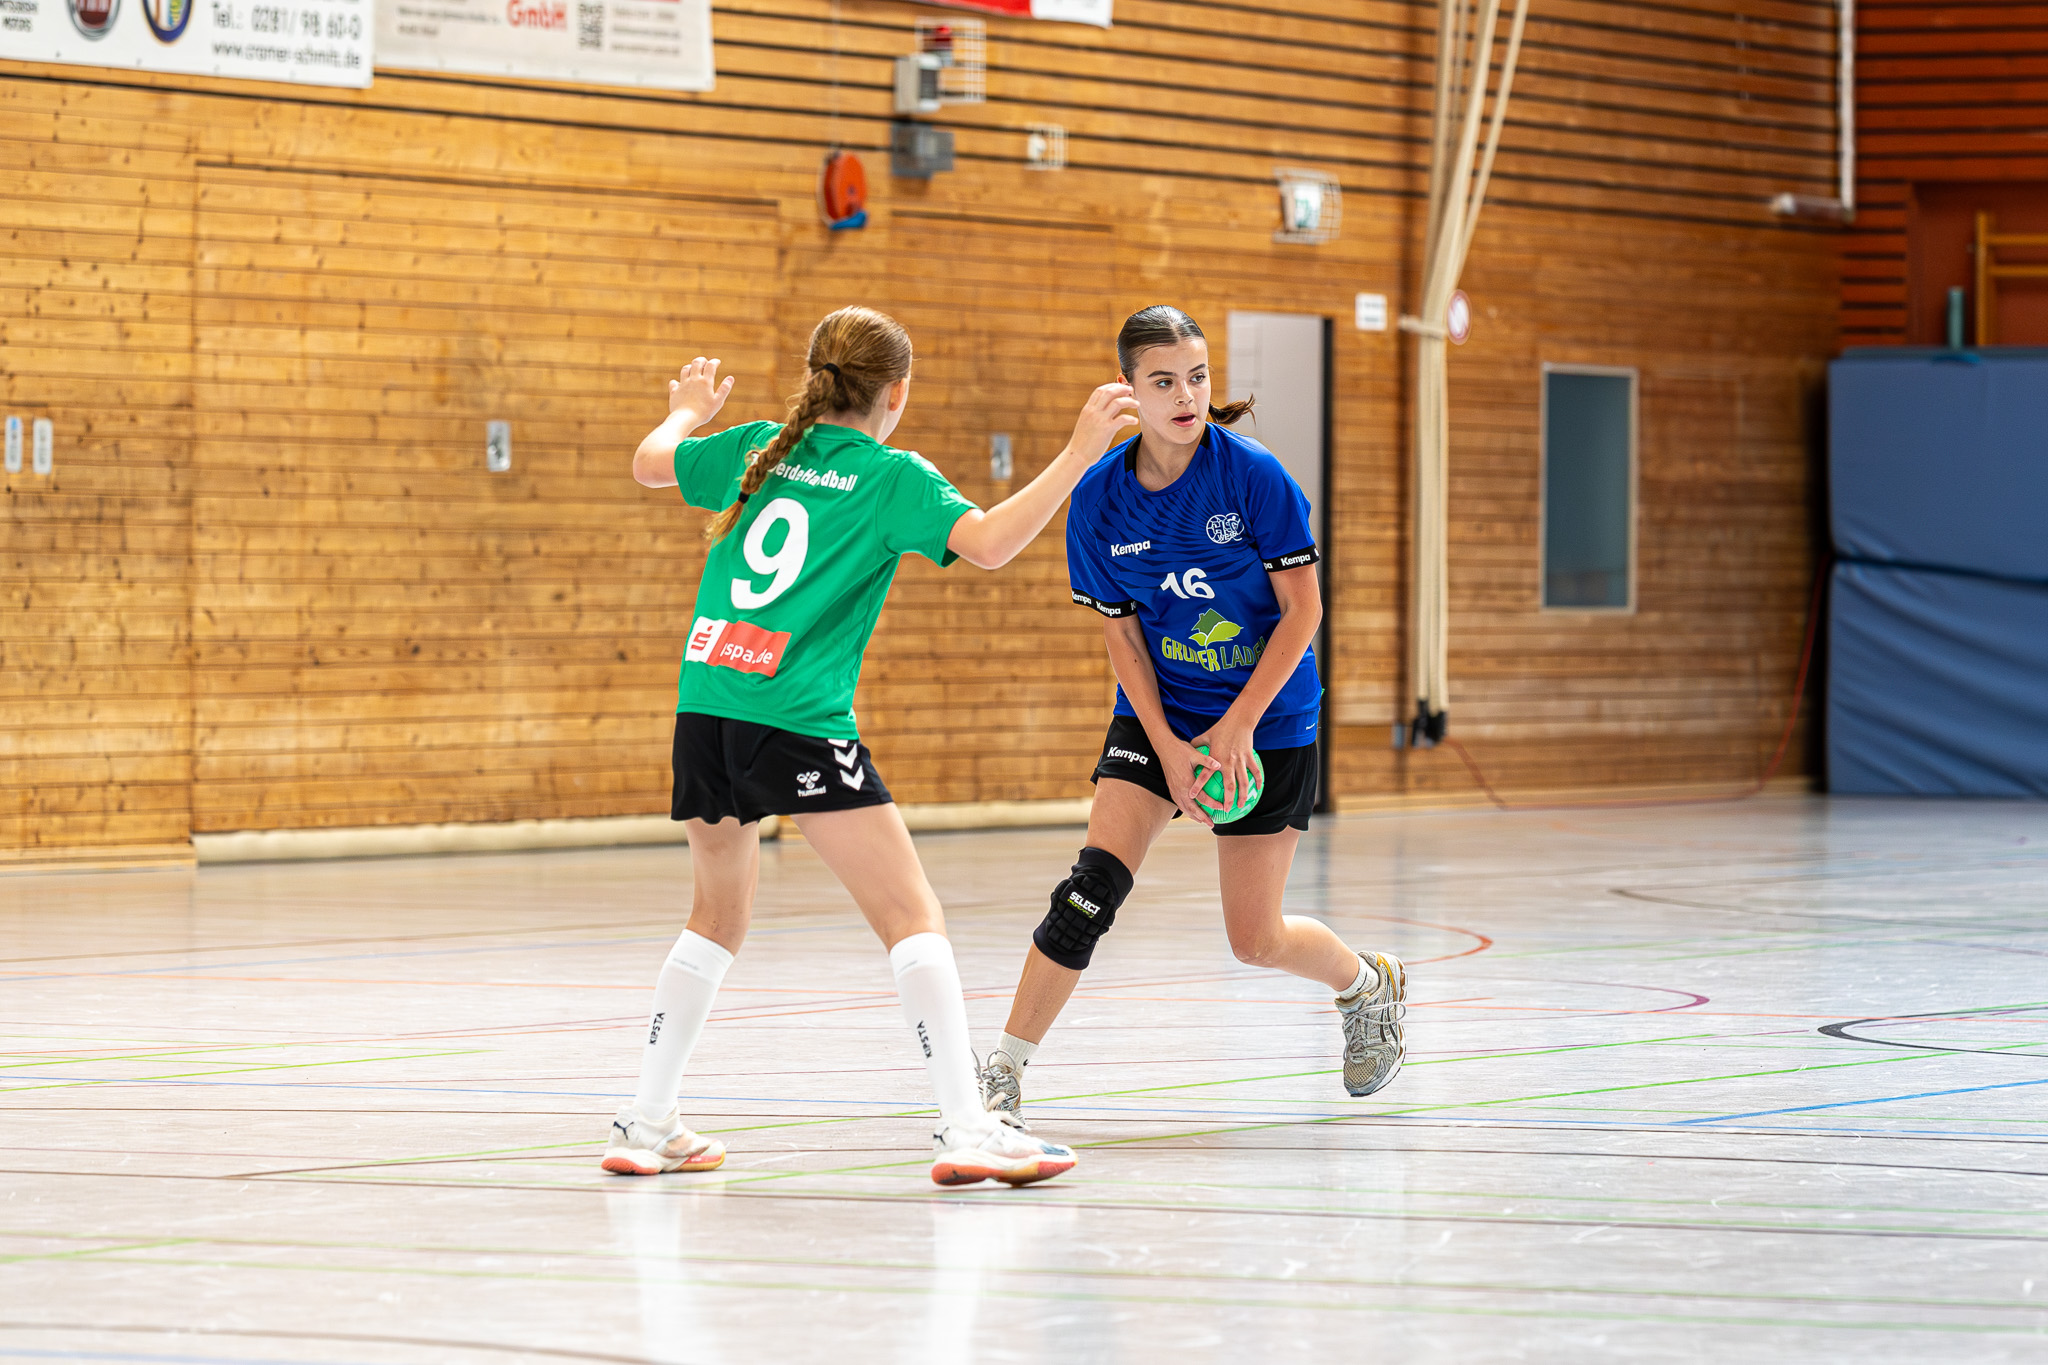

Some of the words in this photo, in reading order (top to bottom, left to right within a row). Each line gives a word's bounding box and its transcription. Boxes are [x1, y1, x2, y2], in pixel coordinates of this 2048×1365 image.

[506, 0, 567, 31] GmbH
[730, 497, 809, 610] 9
[1110, 539, 1151, 557] Kempa
[1280, 554, 1311, 567] Kempa
[1160, 567, 1215, 600] 16
[1095, 600, 1122, 617] Kempa
[1107, 746, 1149, 766] Kempa
[797, 785, 827, 798] hummel
[1069, 891, 1101, 915] SELECT
[649, 1012, 665, 1046] KIPSTA
